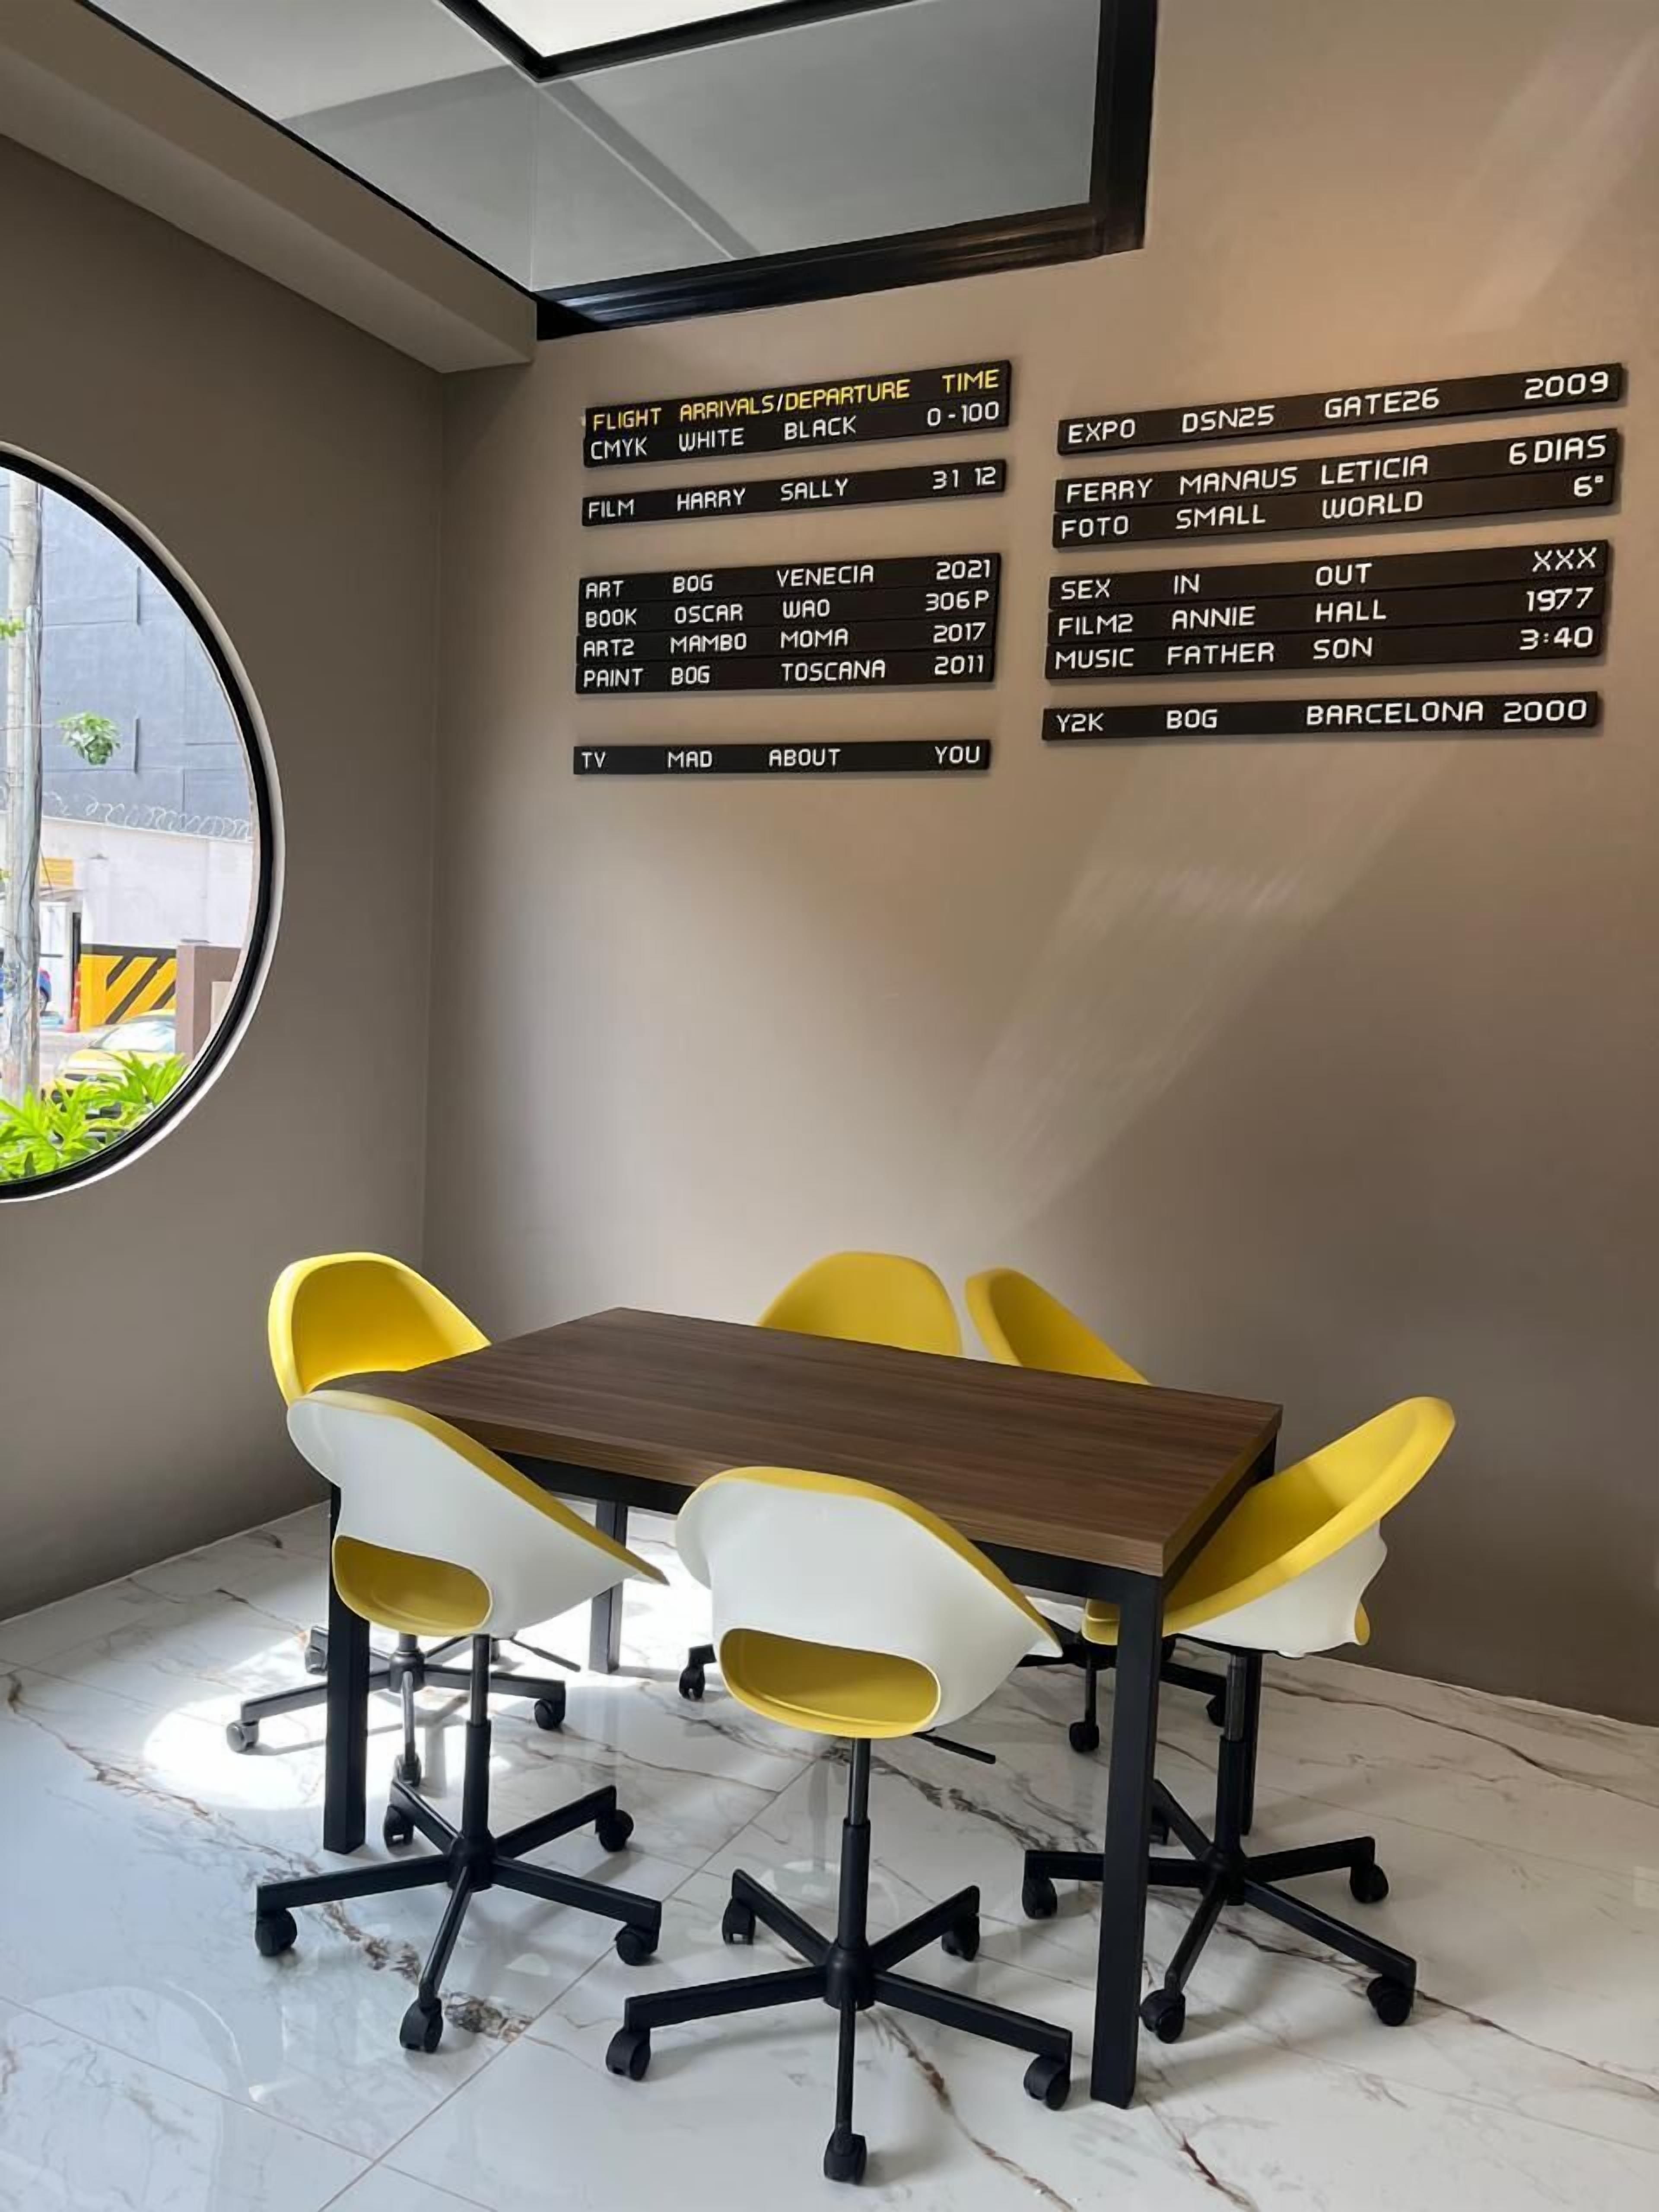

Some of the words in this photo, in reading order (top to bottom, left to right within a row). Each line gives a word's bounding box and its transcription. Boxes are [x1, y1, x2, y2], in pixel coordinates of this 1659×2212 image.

[594, 407, 662, 431] FLIGHT
[679, 378, 911, 423] ARRIVALS/DEPARTURE
[942, 369, 999, 393] TIME
[1068, 419, 1135, 444] EXPO
[1182, 404, 1275, 433] DSN25
[1325, 388, 1440, 419] GATE26
[1525, 371, 1608, 400] 2009
[591, 437, 647, 460] CMYK
[679, 428, 744, 452] WHITE
[785, 415, 856, 441] BLACK
[589, 499, 634, 519] FILM
[677, 488, 745, 511] HARRY
[781, 478, 848, 501] SALLY
[1067, 478, 1153, 503] FERRY
[1180, 466, 1298, 496] MANAUS
[1321, 454, 1428, 485] LETICIA
[1062, 515, 1128, 540] FOTO
[1176, 504, 1266, 529] SMALL
[1322, 491, 1423, 519] WORLD
[586, 580, 624, 599] ART
[673, 574, 713, 593] BOG
[776, 565, 874, 587] VENECIA
[936, 559, 990, 580] 2021
[1061, 578, 1110, 600] SEX
[1174, 573, 1200, 594] IN
[1316, 563, 1373, 586] OUT
[1532, 547, 1597, 572] XXX
[585, 608, 637, 628] BOOK
[675, 604, 743, 624] OSCAR
[783, 599, 830, 619] WAO
[1058, 613, 1133, 636] FILM2
[1172, 606, 1256, 630] ANNIE
[1316, 599, 1386, 623] HALL
[1526, 587, 1594, 612] 1977
[584, 638, 634, 658] ART2
[671, 632, 747, 653] MAMBO
[781, 628, 848, 648] MOMA
[933, 622, 986, 643] 2017
[1055, 648, 1134, 670] MUSIC
[1168, 642, 1274, 665] FATHER
[1313, 637, 1373, 659] SON
[1519, 626, 1593, 650] 3:40
[584, 668, 643, 687] PAINT
[671, 665, 710, 685] BOG
[781, 659, 886, 681] TOSCANA
[934, 655, 983, 675] 2011
[1056, 713, 1104, 733] Y2K
[1166, 709, 1217, 729] BOG
[1306, 701, 1483, 725] BARCELONA
[1503, 699, 1587, 723] 2000
[582, 751, 606, 769] TV
[668, 750, 712, 768] MAD
[769, 748, 841, 766] ABOUT
[935, 746, 980, 764] YOU
